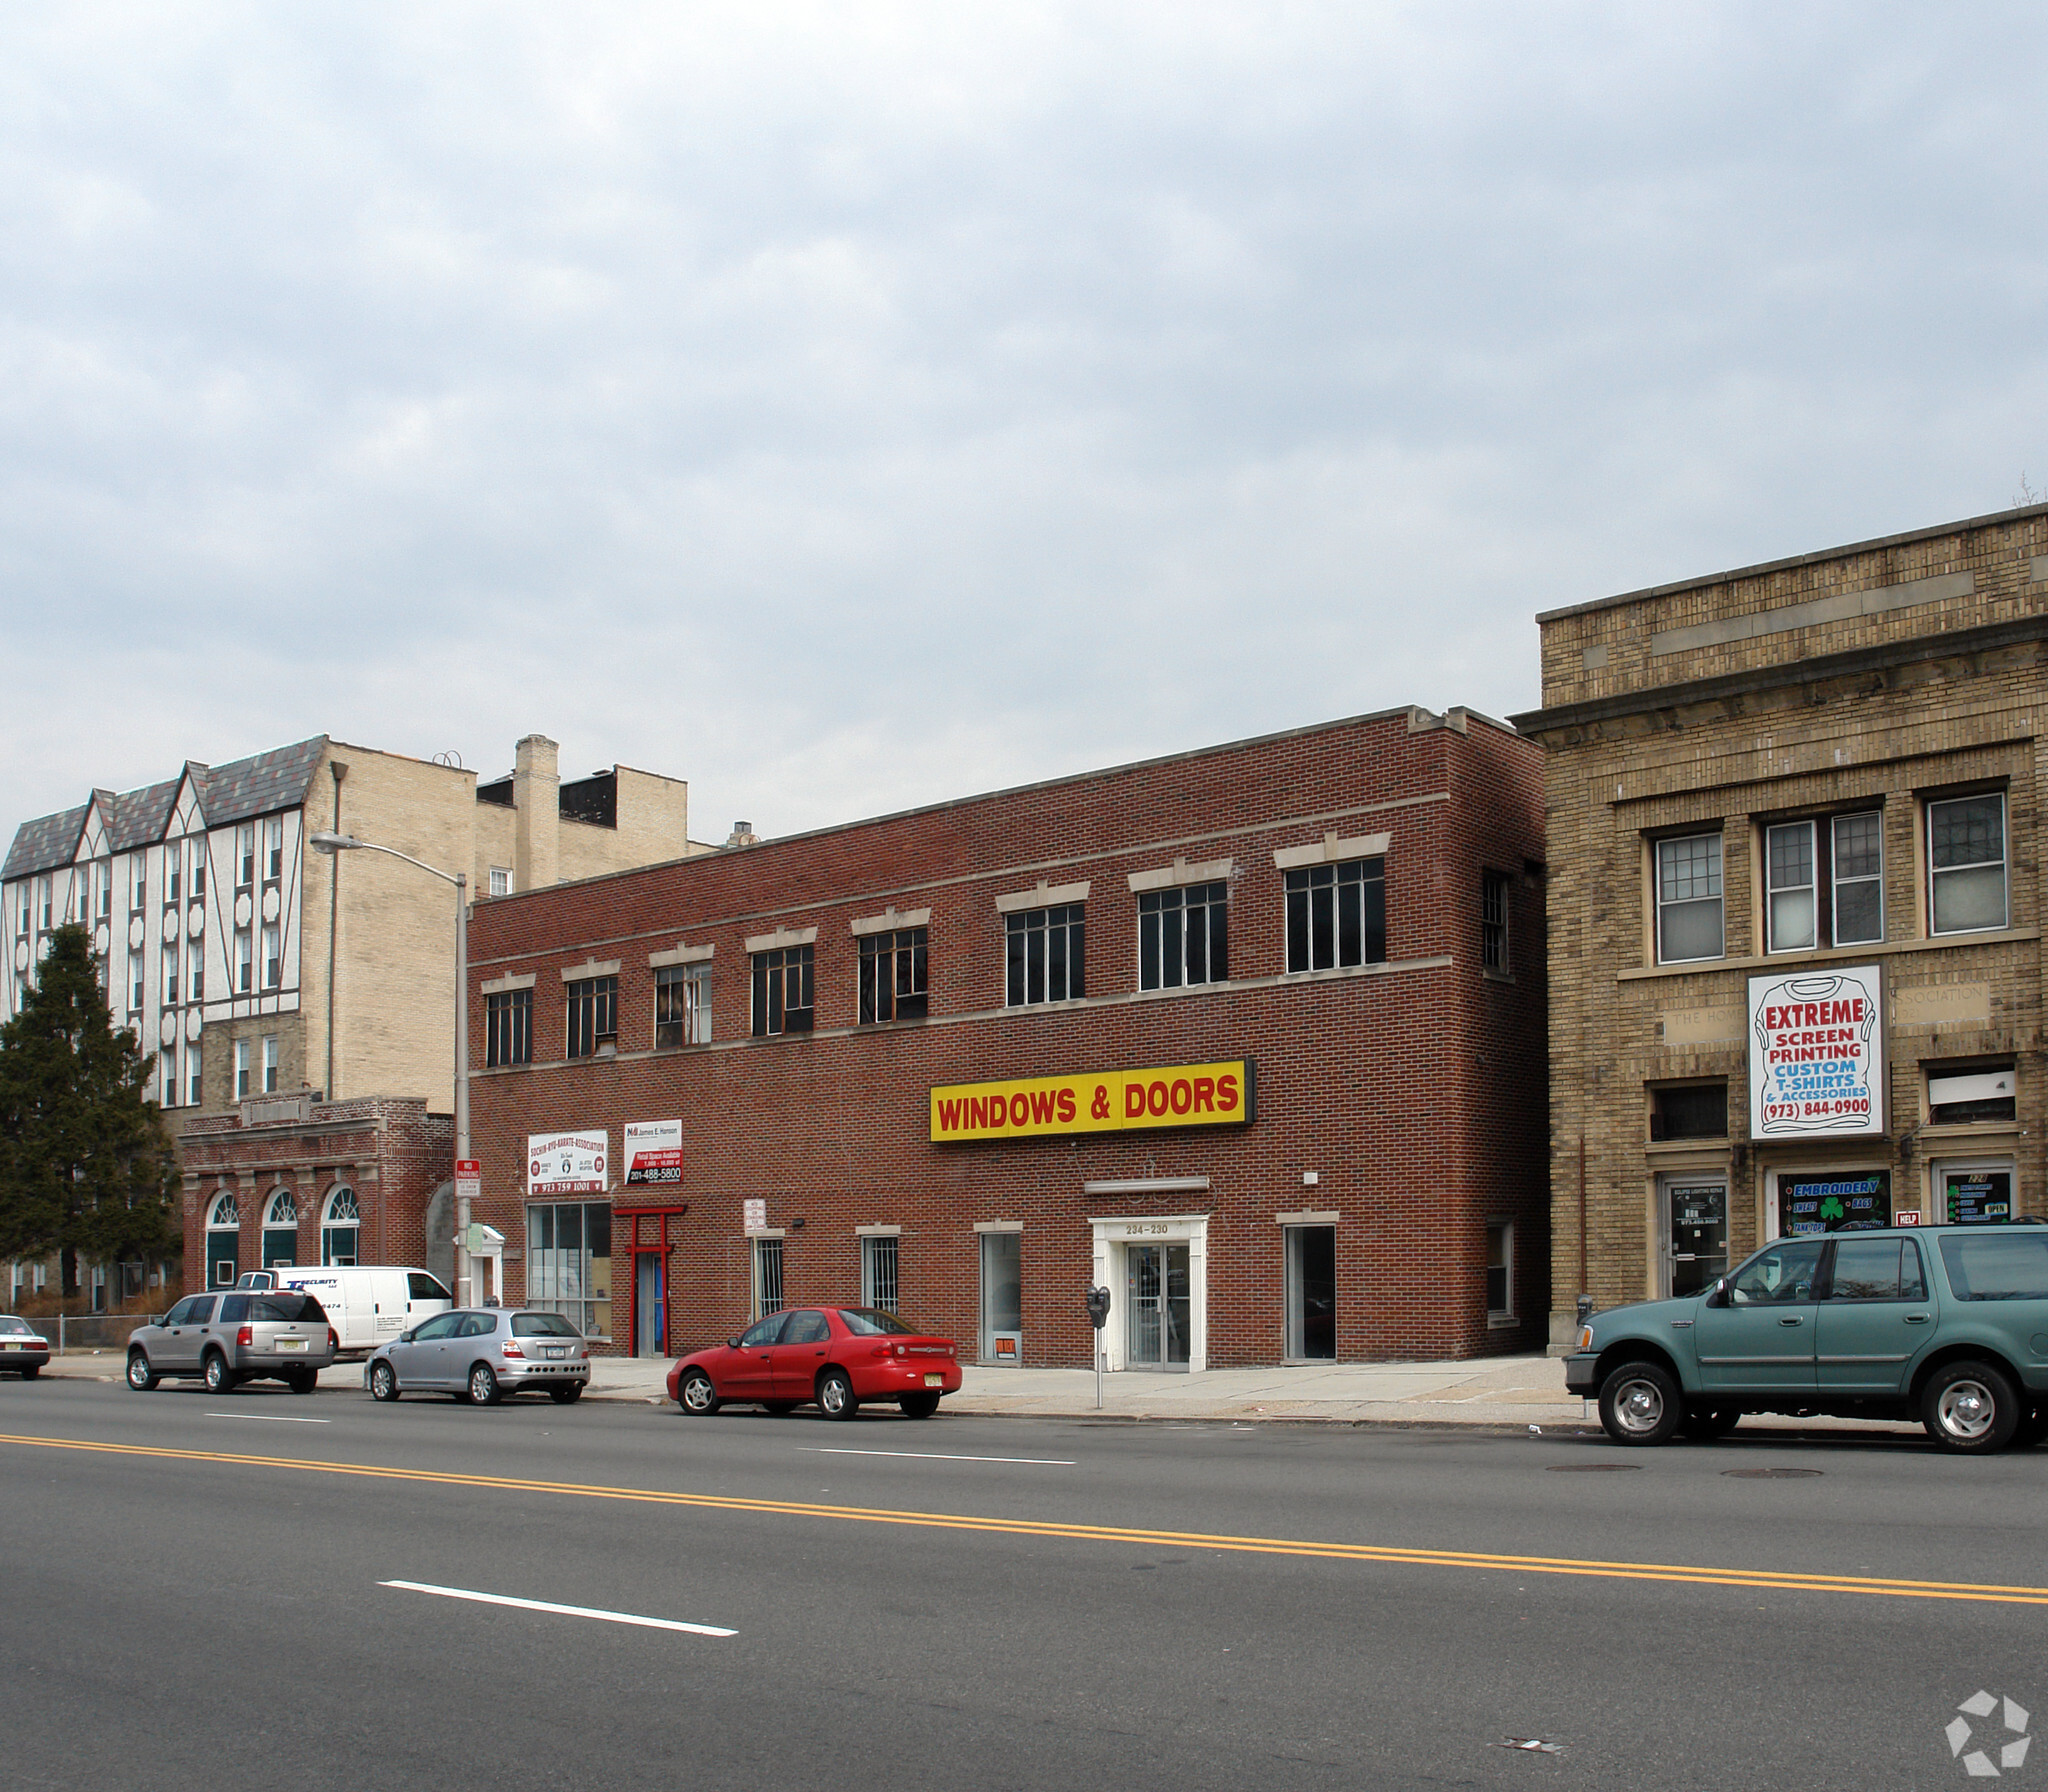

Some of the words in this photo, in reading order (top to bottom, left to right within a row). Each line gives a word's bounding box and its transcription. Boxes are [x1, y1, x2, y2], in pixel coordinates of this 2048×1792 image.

[1673, 1012, 1701, 1025] THE
[1708, 1008, 1745, 1021] HOME
[1766, 998, 1864, 1030] EXTREME
[1776, 1028, 1854, 1047] SCREEN
[1769, 1043, 1861, 1064] PRINTING
[1774, 1060, 1856, 1078] CUSTOM
[1776, 1074, 1855, 1091] T-SHIRTS
[1766, 1093, 1777, 1102] &
[1781, 1087, 1866, 1102] ACCESSORIES
[938, 1088, 1077, 1131] WINDOWS
[1091, 1085, 1110, 1120] &
[1125, 1074, 1239, 1118] DOORS
[1764, 1102, 1800, 1122] (973)
[1804, 1098, 1869, 1116] 844-0900
[463, 1162, 473, 1170] NO
[630, 1167, 681, 1180] 201-488-5800
[541, 1183, 555, 1192] 973
[557, 1182, 571, 1192] 759
[573, 1181, 590, 1191] 1001
[1793, 1181, 1880, 1197] EMBROIDERY
[1793, 1202, 1817, 1213] SWEATS
[1851, 1198, 1872, 1209] BAGS
[1987, 1204, 2005, 1214] OPEN
[1900, 1214, 1917, 1224] HELP
[1126, 1224, 1168, 1235] 234-230
[301, 1278, 338, 1286] SECURITY
